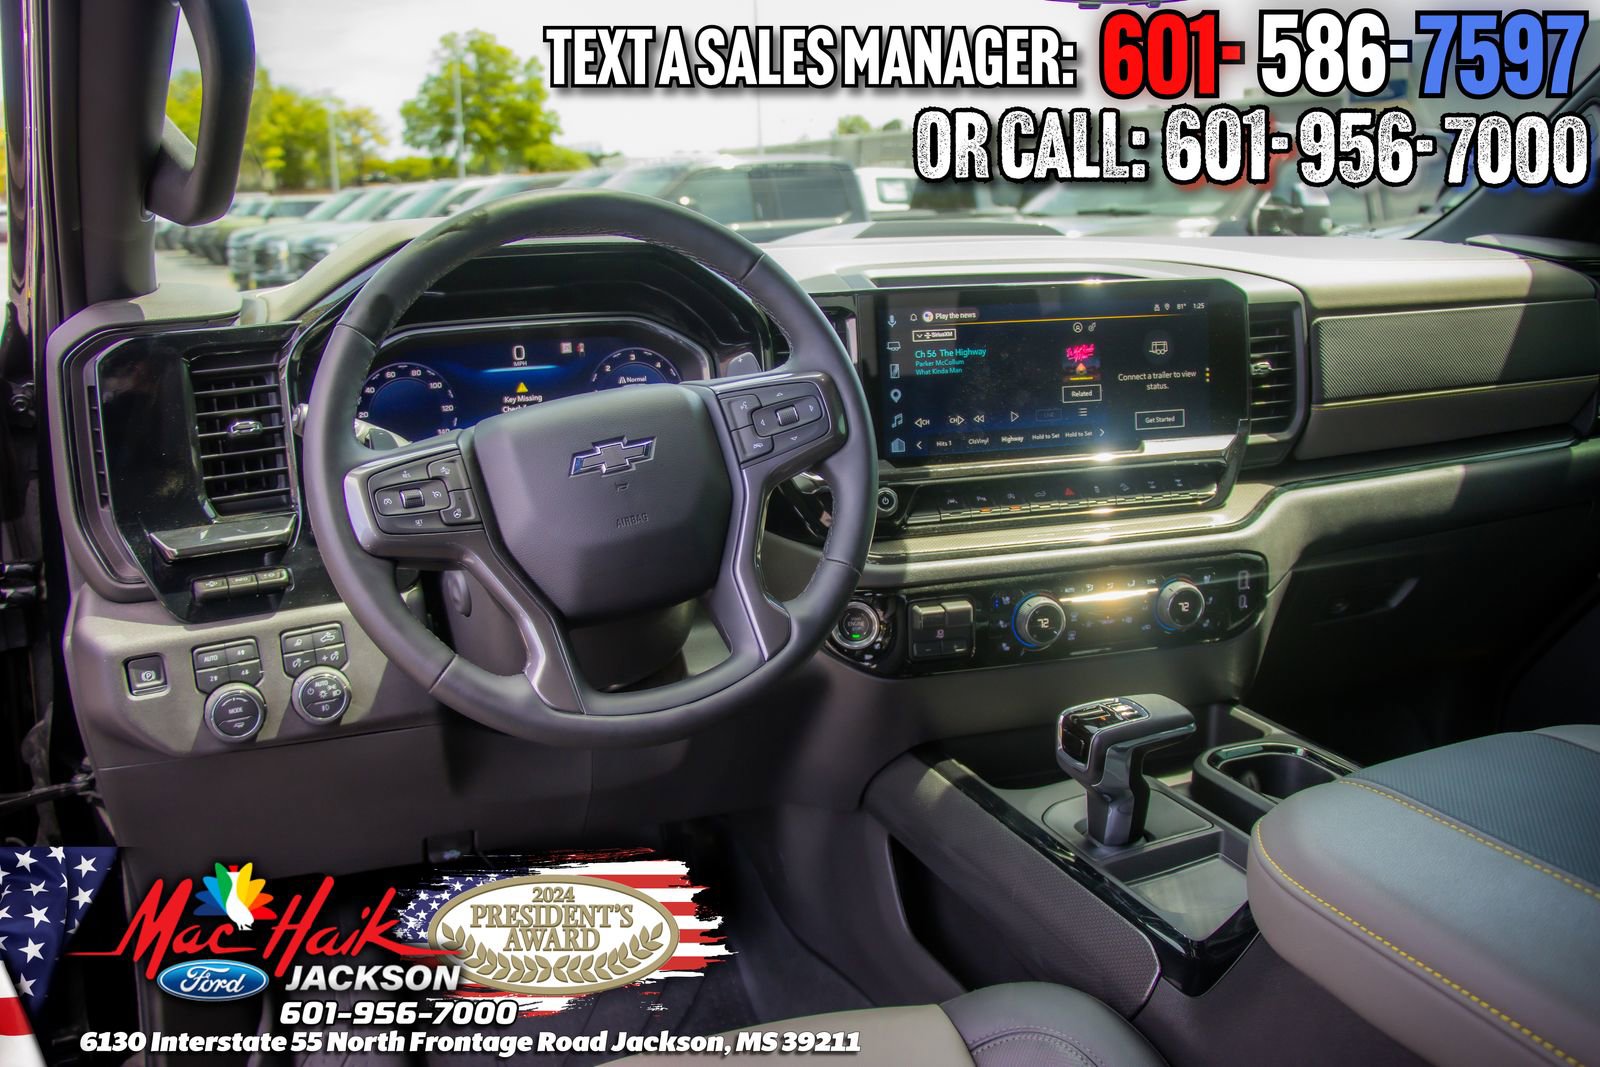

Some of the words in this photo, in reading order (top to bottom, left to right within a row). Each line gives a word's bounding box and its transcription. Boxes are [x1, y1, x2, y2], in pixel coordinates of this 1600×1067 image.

[1193, 302, 1205, 310] 1:25
[935, 312, 948, 320] Play
[512, 345, 526, 361] 0
[915, 350, 926, 358] Ch
[926, 350, 937, 358] 56
[955, 348, 987, 358] Highway
[626, 375, 648, 383] Normal
[1118, 374, 1147, 382] Connect
[1152, 372, 1172, 380] trailer
[1182, 370, 1197, 378] view
[365, 386, 376, 394] 40
[1146, 382, 1170, 390] status.
[1071, 390, 1092, 398] Related
[504, 396, 516, 404] Key
[517, 394, 542, 402] Missing
[442, 404, 454, 412] 120
[1001, 435, 1024, 444] Highway
[616, 512, 648, 528] AIRBAG
[1178, 602, 1190, 612] 72
[1036, 618, 1050, 628] 72
[204, 654, 218, 662] AUTO
[315, 680, 328, 688] AUTO
